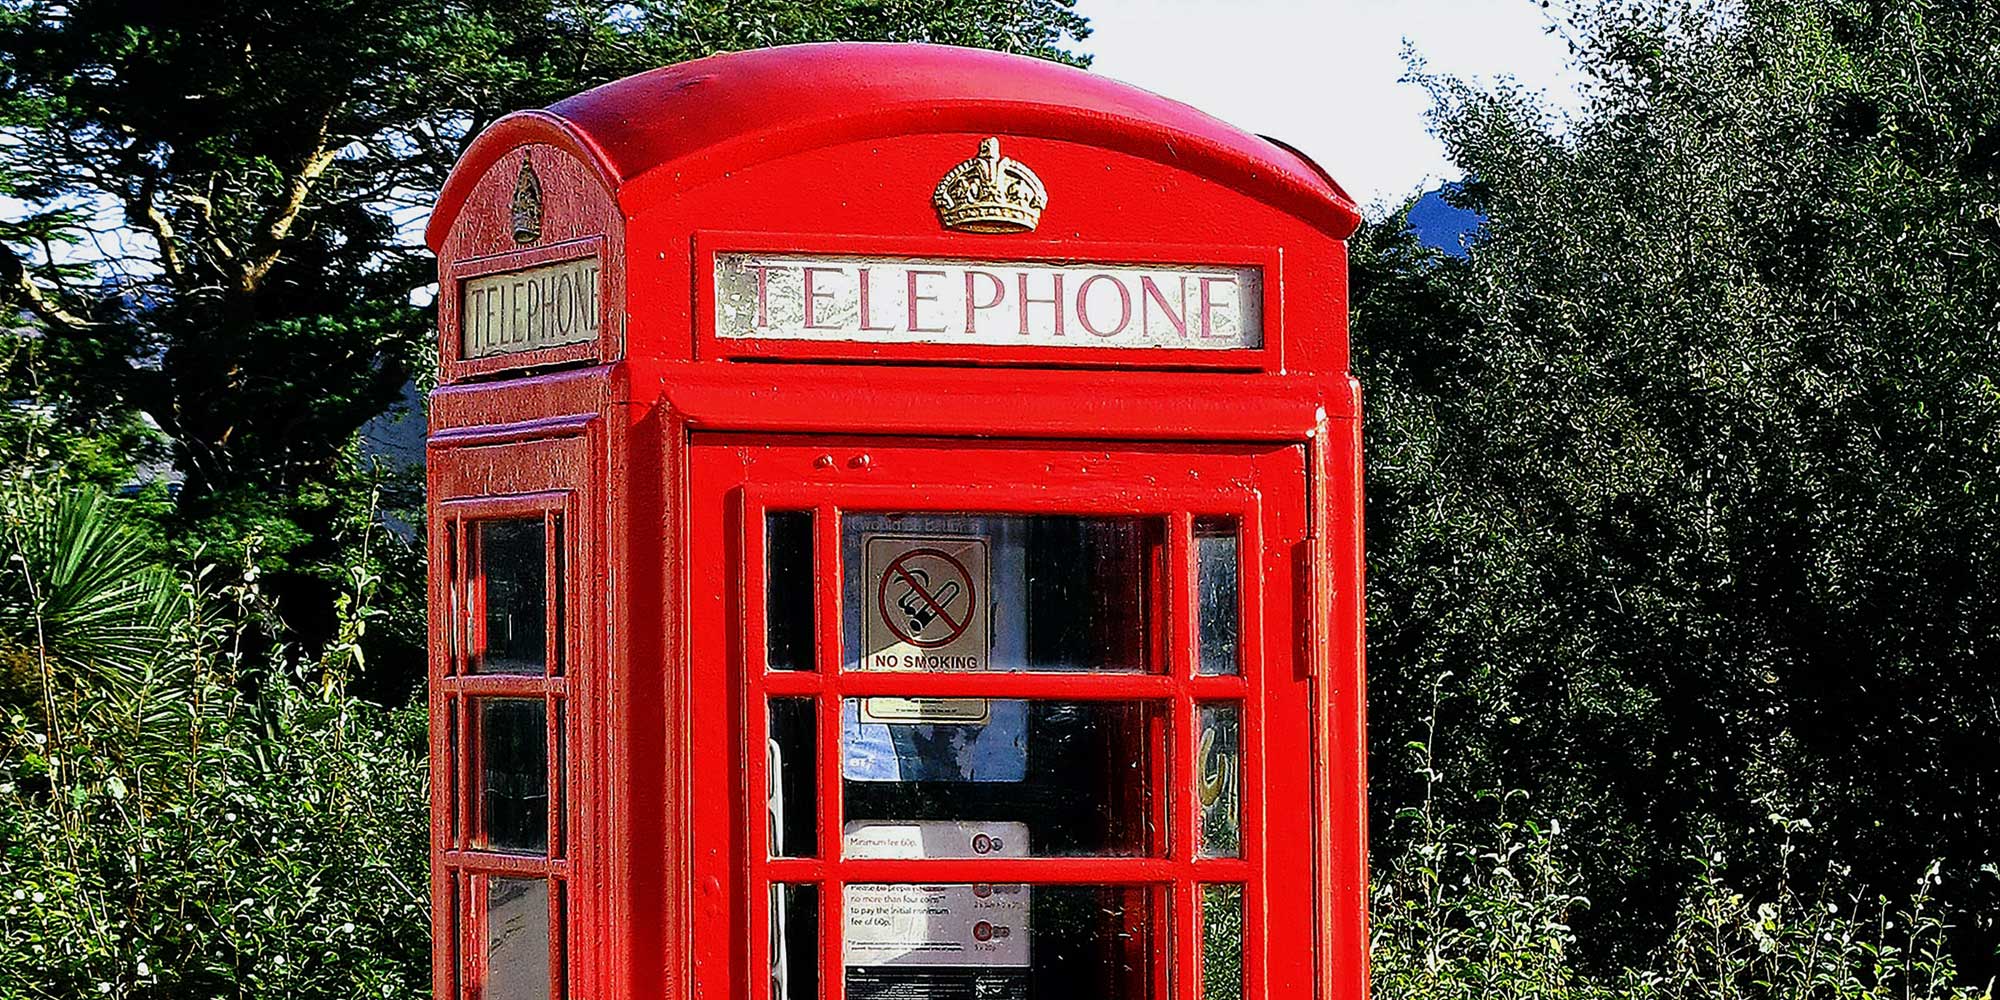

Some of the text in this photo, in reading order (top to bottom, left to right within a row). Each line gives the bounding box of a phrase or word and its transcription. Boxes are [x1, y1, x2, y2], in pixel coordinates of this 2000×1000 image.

[744, 264, 1238, 339] TELEPHONE
[472, 267, 600, 349] TELEPHONE
[875, 655, 978, 669] NO SMOKING
[850, 837, 887, 846] Minimum
[888, 838, 899, 846] fee
[884, 895, 901, 903] than
[903, 894, 918, 903] four
[861, 908, 874, 916] pay
[876, 906, 889, 914] the
[850, 917, 862, 926] fee
